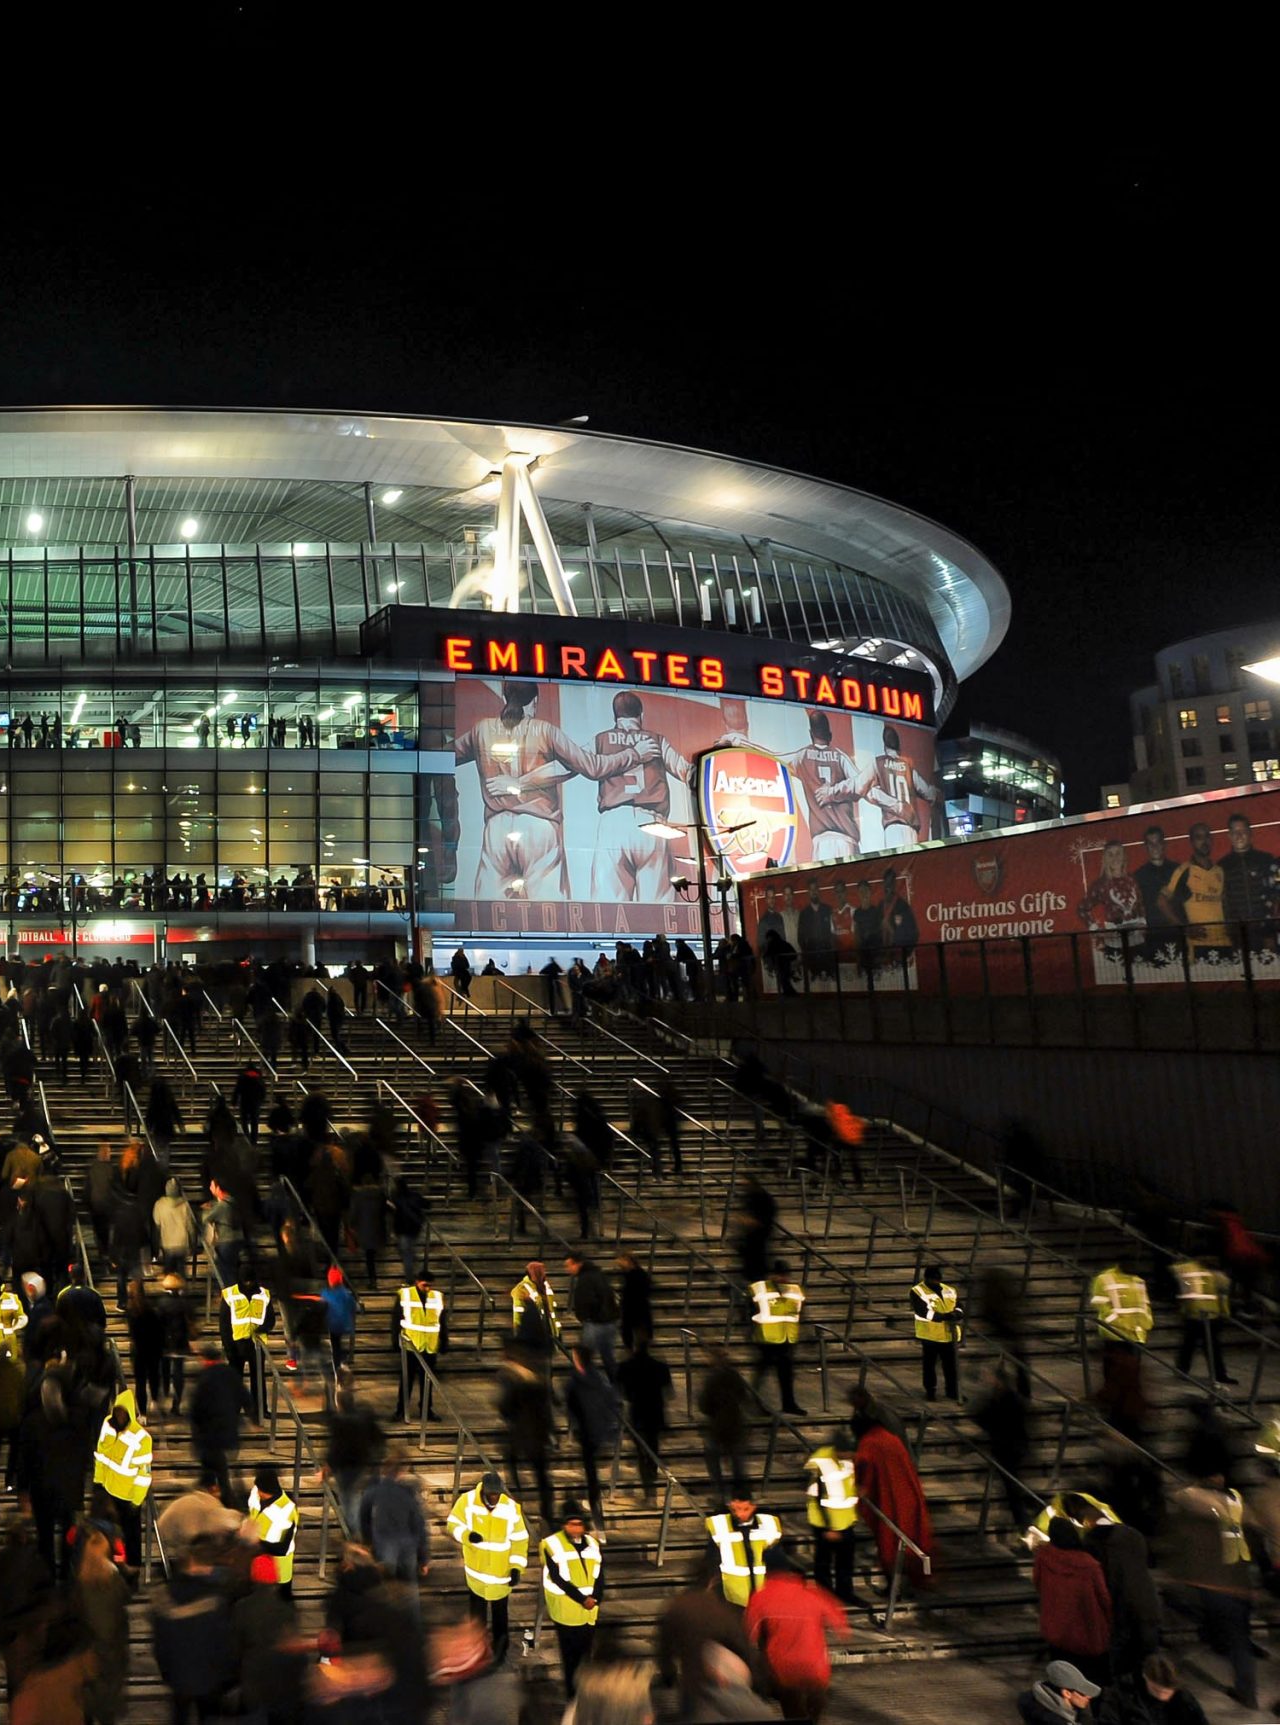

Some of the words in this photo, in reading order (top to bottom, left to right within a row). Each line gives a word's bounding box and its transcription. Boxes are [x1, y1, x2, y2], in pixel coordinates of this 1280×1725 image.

[447, 638, 724, 689] EMIRATES
[760, 665, 924, 720] STADIUM
[471, 901, 631, 933] ICTORIA
[926, 899, 1016, 923] Christmas
[1020, 890, 1067, 917] Gifts
[941, 922, 965, 943] for
[967, 918, 1055, 941] everyone
